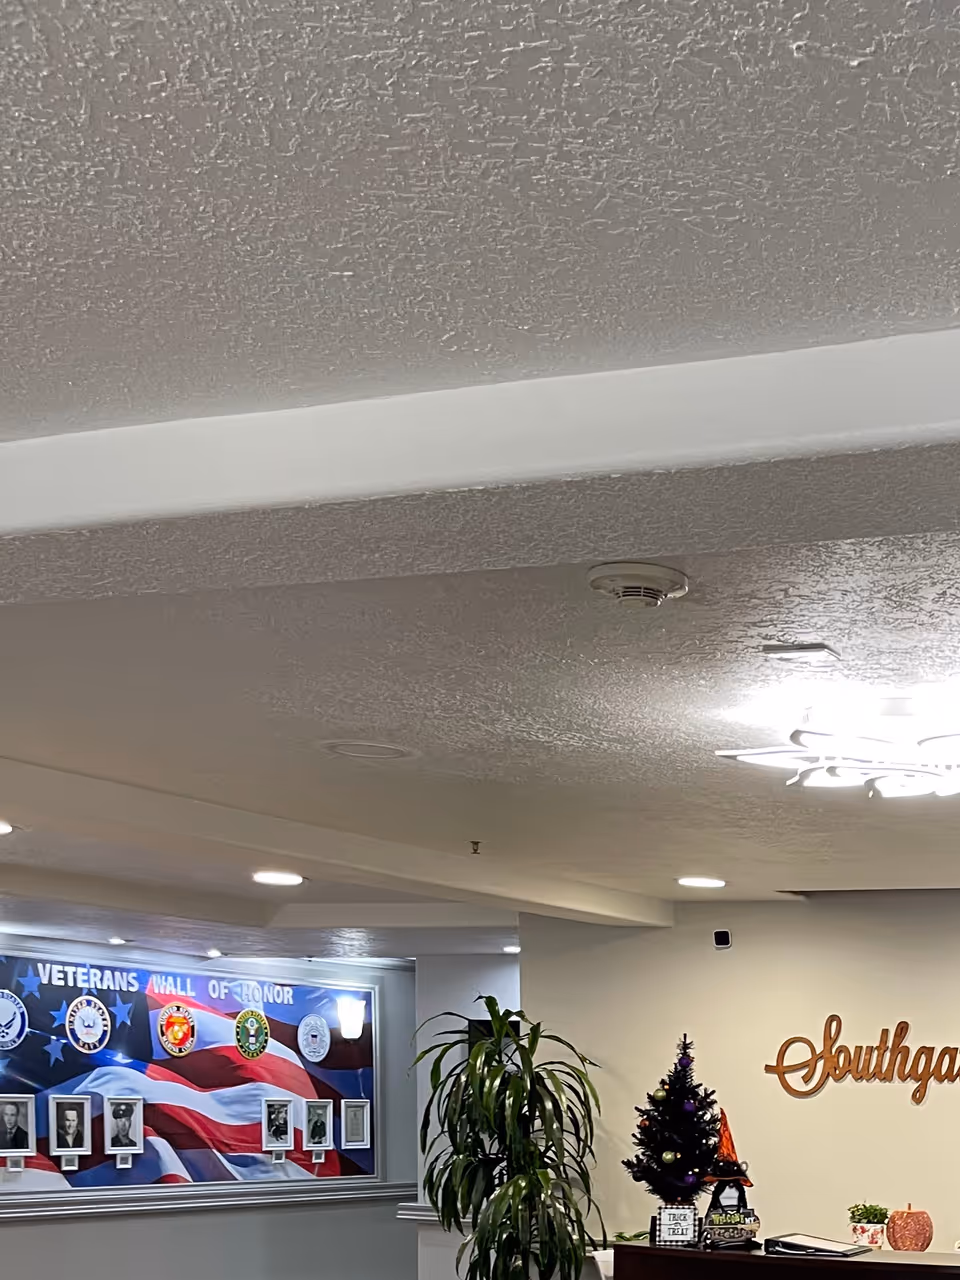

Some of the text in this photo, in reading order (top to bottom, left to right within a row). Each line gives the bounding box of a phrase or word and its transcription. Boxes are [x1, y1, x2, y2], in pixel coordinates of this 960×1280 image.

[37, 962, 294, 1005] VETERANS WALL OF HONOR
